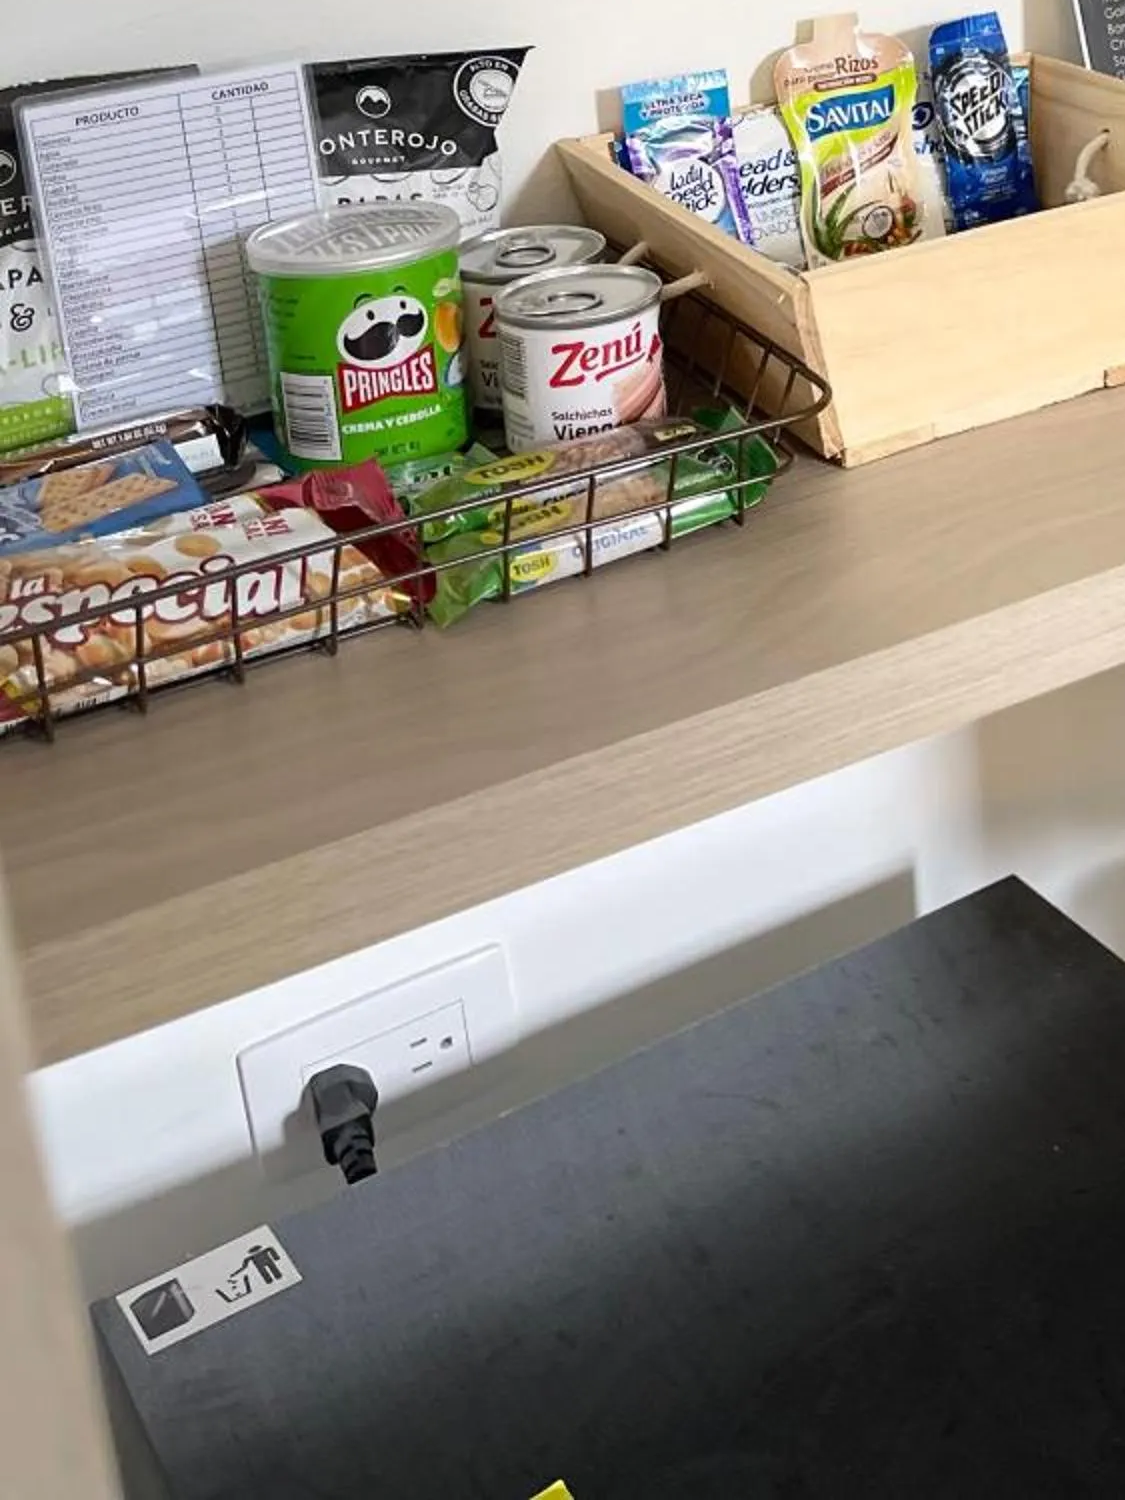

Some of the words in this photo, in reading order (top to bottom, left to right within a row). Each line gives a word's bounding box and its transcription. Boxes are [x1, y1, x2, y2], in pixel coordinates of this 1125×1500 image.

[834, 55, 879, 75] Rizos
[74, 106, 139, 127] PRODUCTO
[211, 81, 269, 101] CANTIDAD
[950, 69, 1005, 116] SPEED
[807, 97, 892, 133] SAVITAL
[962, 92, 1008, 136] STICK
[318, 128, 457, 156] ONTEROJO
[739, 147, 783, 178] ead
[548, 321, 644, 389] Zenú
[342, 350, 435, 408] PRINGLES
[341, 421, 385, 435] CREMA
[385, 418, 396, 430] Y
[395, 404, 442, 427] CEBOLLA
[551, 407, 613, 421] Salchichas
[476, 454, 547, 480] TOSH
[571, 523, 649, 559] OIGINAL
[513, 554, 551, 576] TOSH
[10, 577, 45, 599] la
